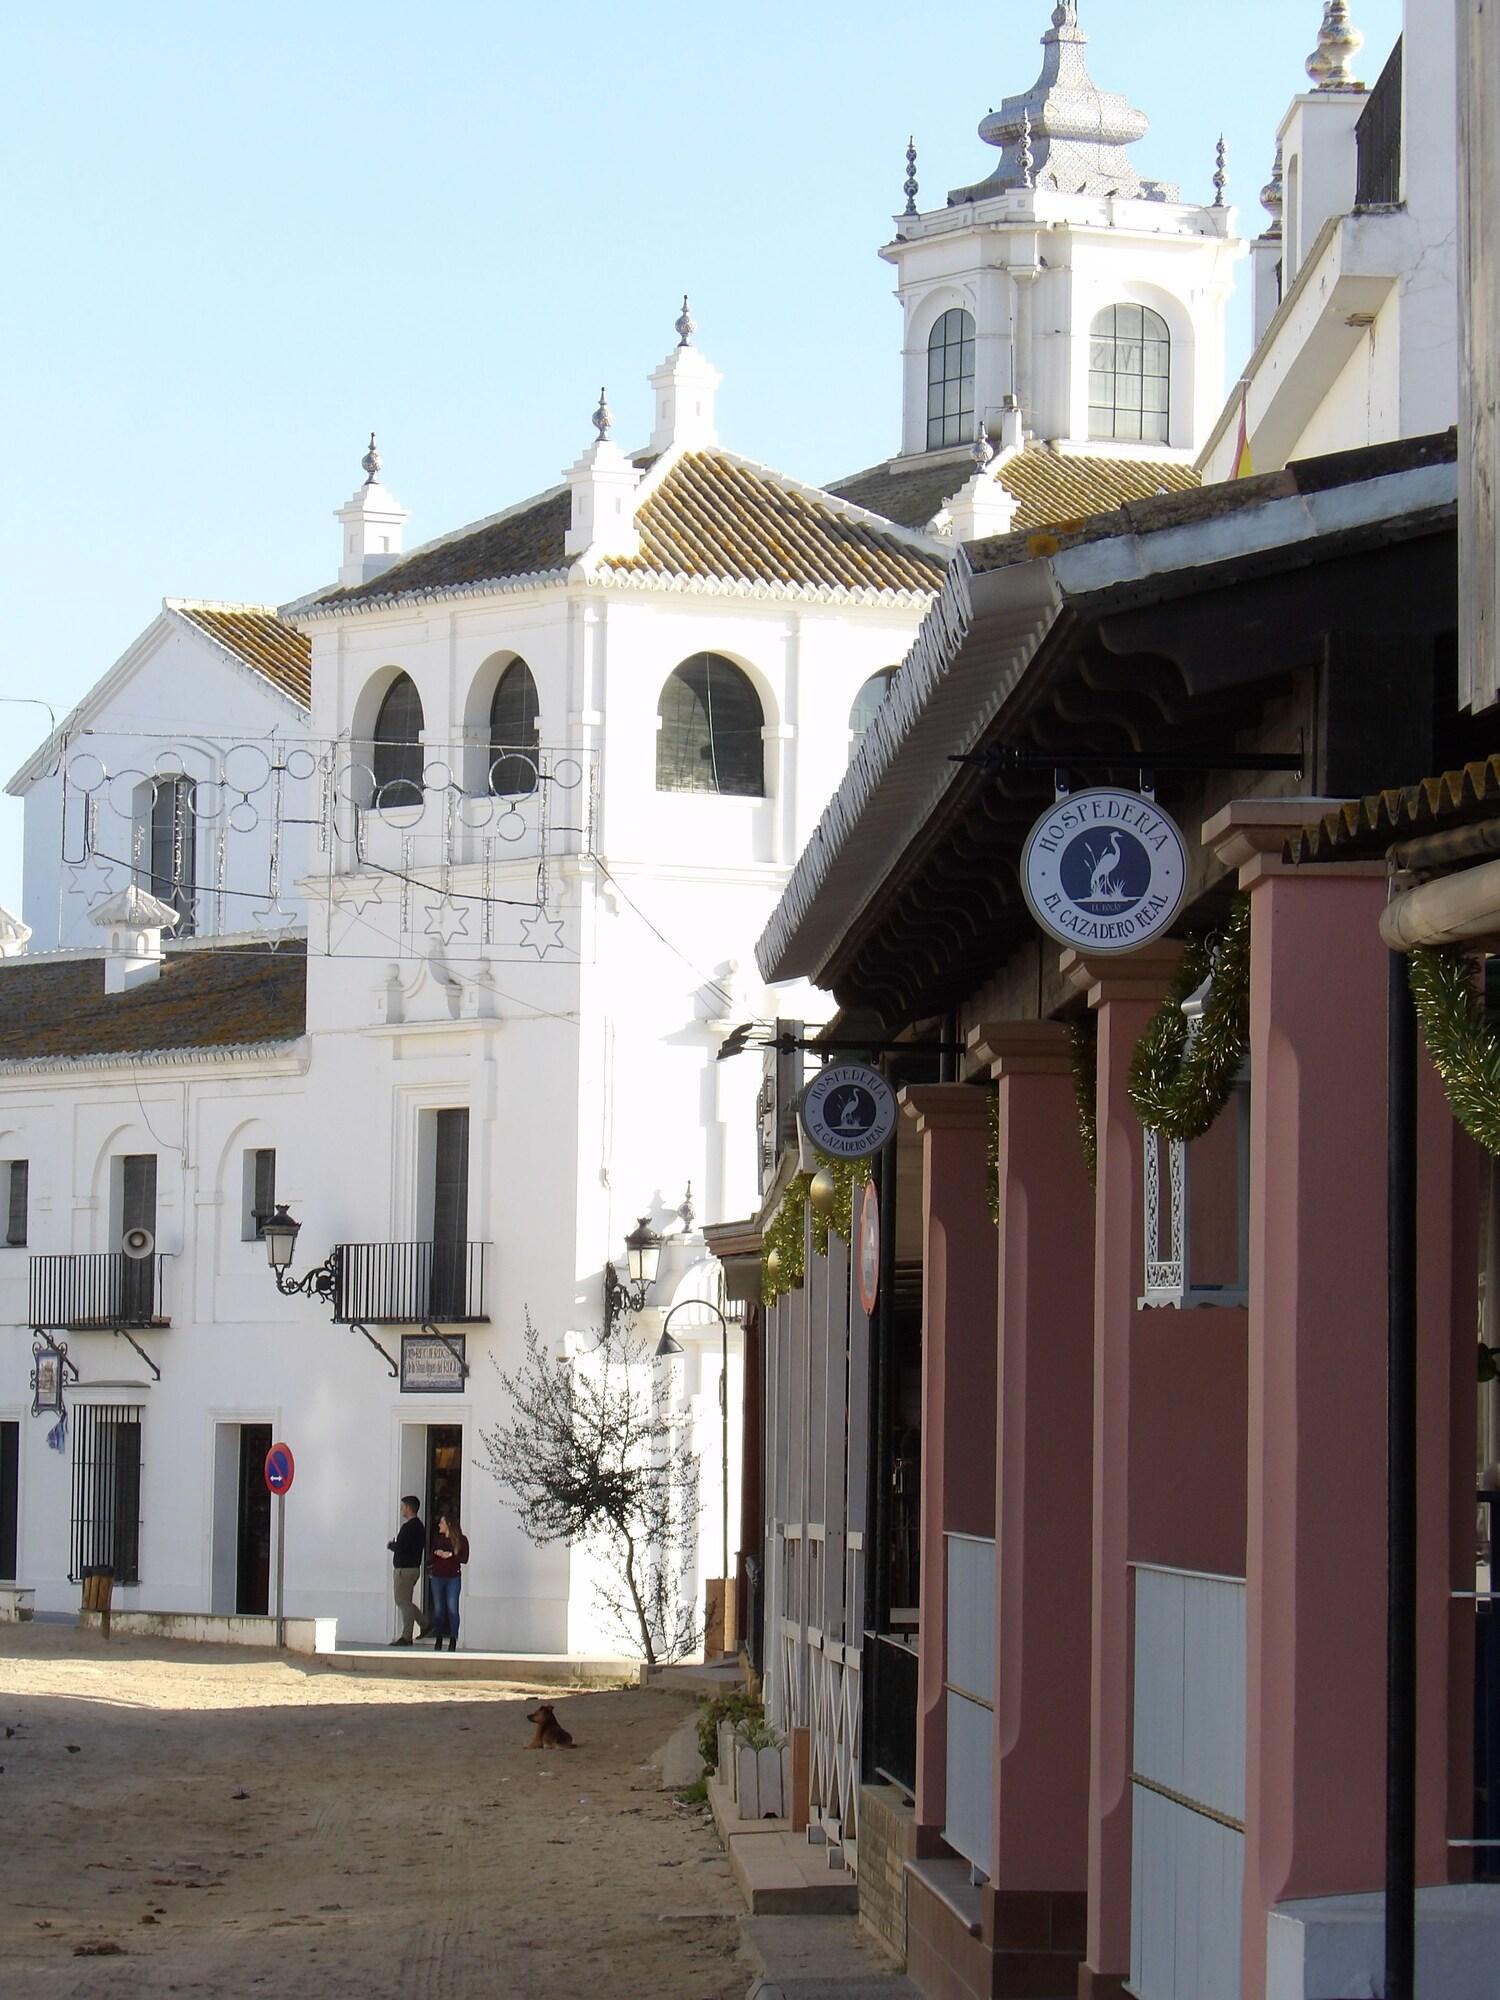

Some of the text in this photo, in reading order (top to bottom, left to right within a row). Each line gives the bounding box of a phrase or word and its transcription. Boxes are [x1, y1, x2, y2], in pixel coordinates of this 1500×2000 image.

[1039, 800, 1168, 852] HOSPEDERÍA
[1043, 893, 1169, 939] EL CAZADERO REAL
[813, 1123, 887, 1152] EL CAZADERO REAL
